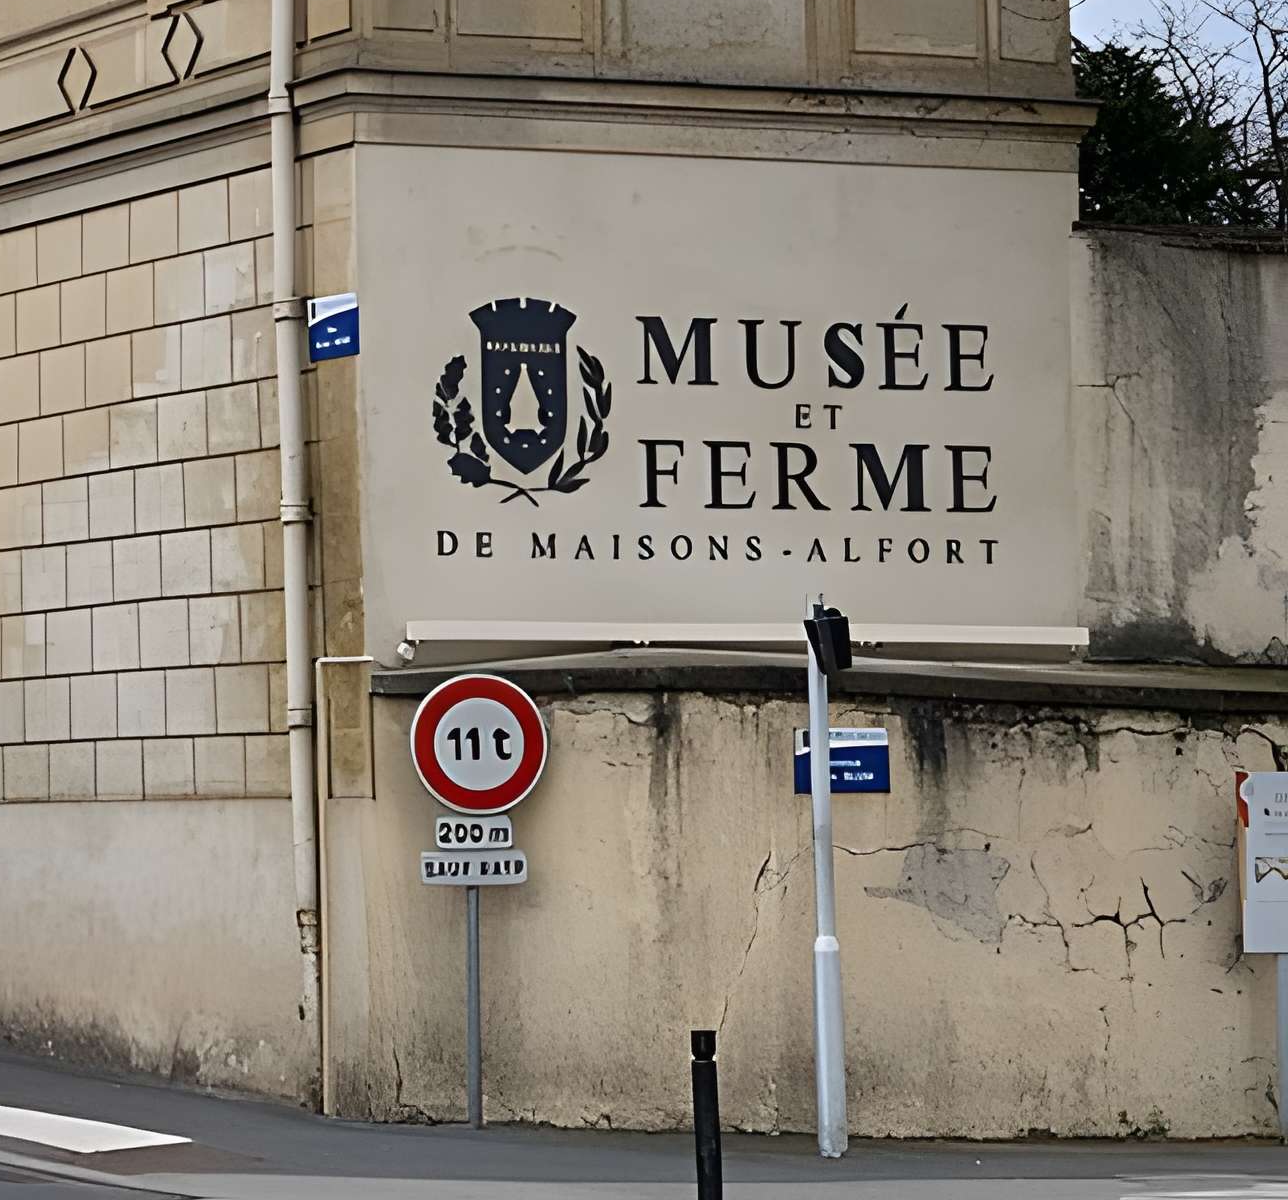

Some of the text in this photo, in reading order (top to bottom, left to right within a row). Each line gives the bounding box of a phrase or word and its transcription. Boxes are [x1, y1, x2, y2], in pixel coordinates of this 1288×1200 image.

[635, 302, 995, 392] MUSÉE
[794, 403, 844, 431] ET
[637, 439, 998, 513] FERME
[436, 530, 494, 558] DE
